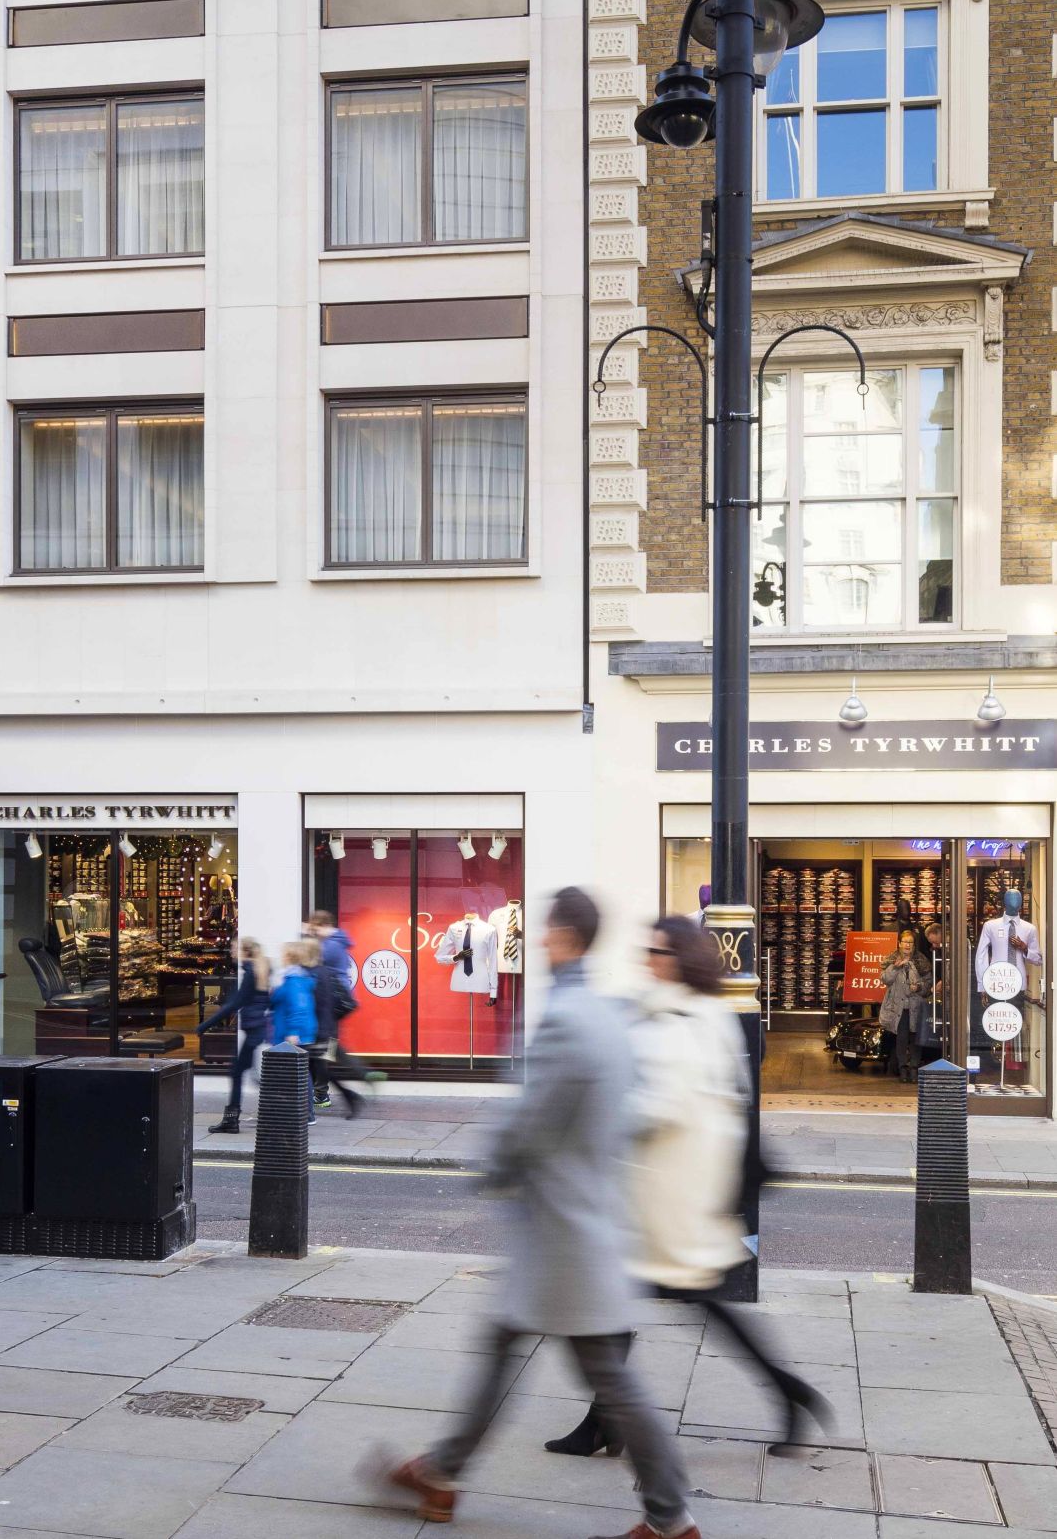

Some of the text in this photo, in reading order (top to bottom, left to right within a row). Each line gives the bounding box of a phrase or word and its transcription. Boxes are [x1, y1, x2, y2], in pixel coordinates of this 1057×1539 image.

[674, 737, 1040, 754] CHRLES TYRWHITT
[105, 805, 236, 818] TYRWHITT
[370, 959, 400, 969] SALE
[861, 966, 879, 974] from
[369, 975, 401, 989] 45%
[989, 982, 1016, 993] 45%
[988, 1023, 1018, 1033] £17.95
